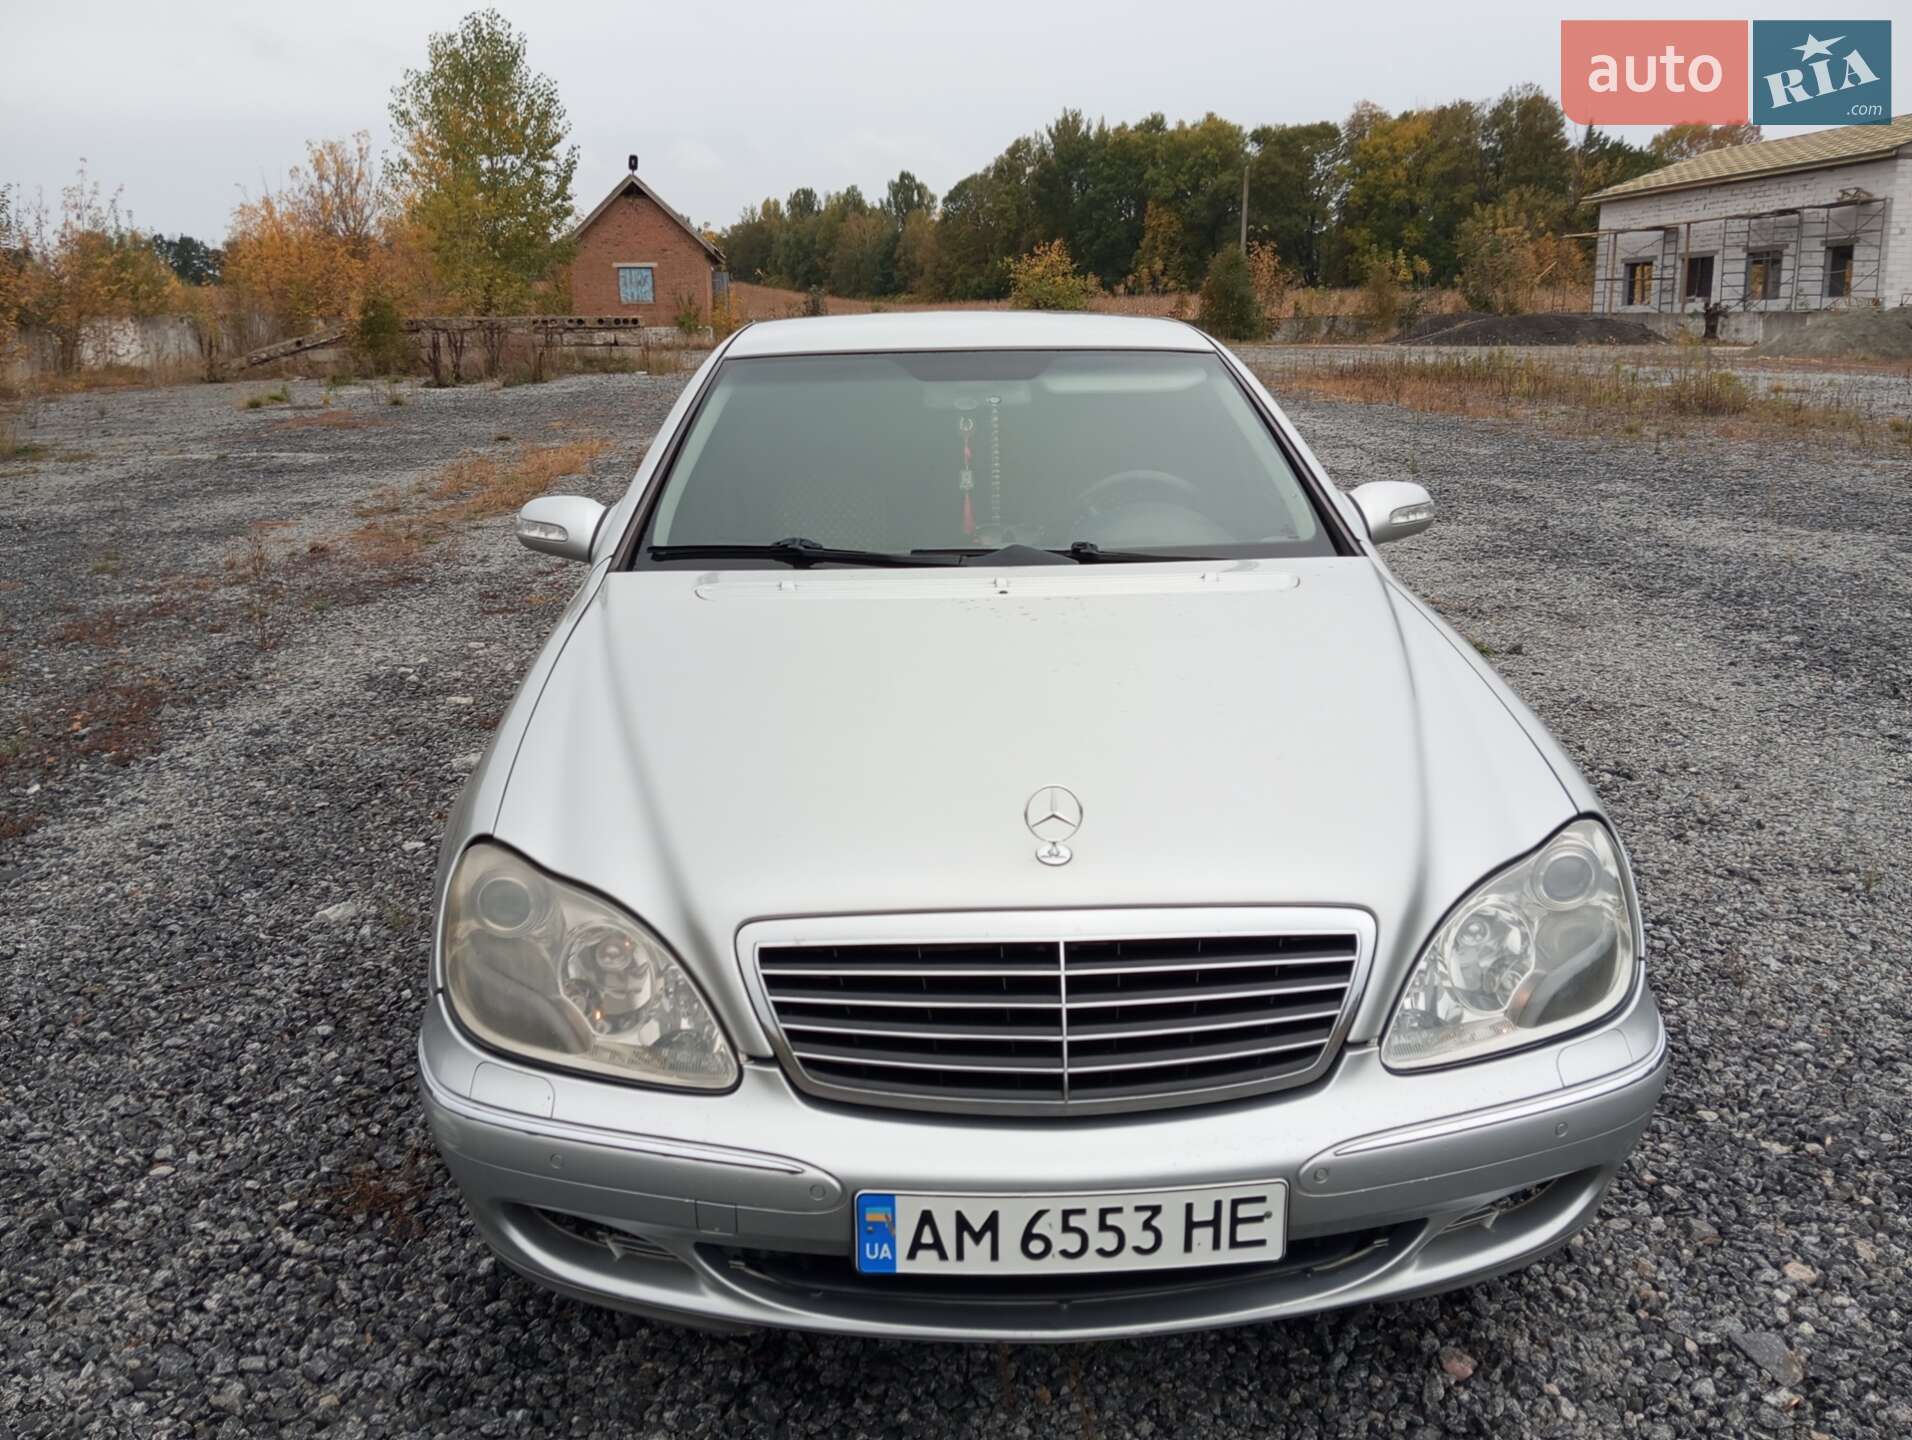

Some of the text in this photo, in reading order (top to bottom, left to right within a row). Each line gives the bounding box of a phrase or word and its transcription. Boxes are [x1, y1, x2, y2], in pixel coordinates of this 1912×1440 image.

[906, 1195, 1267, 1262] AM 6553 HE
[865, 1243, 892, 1260] UA
